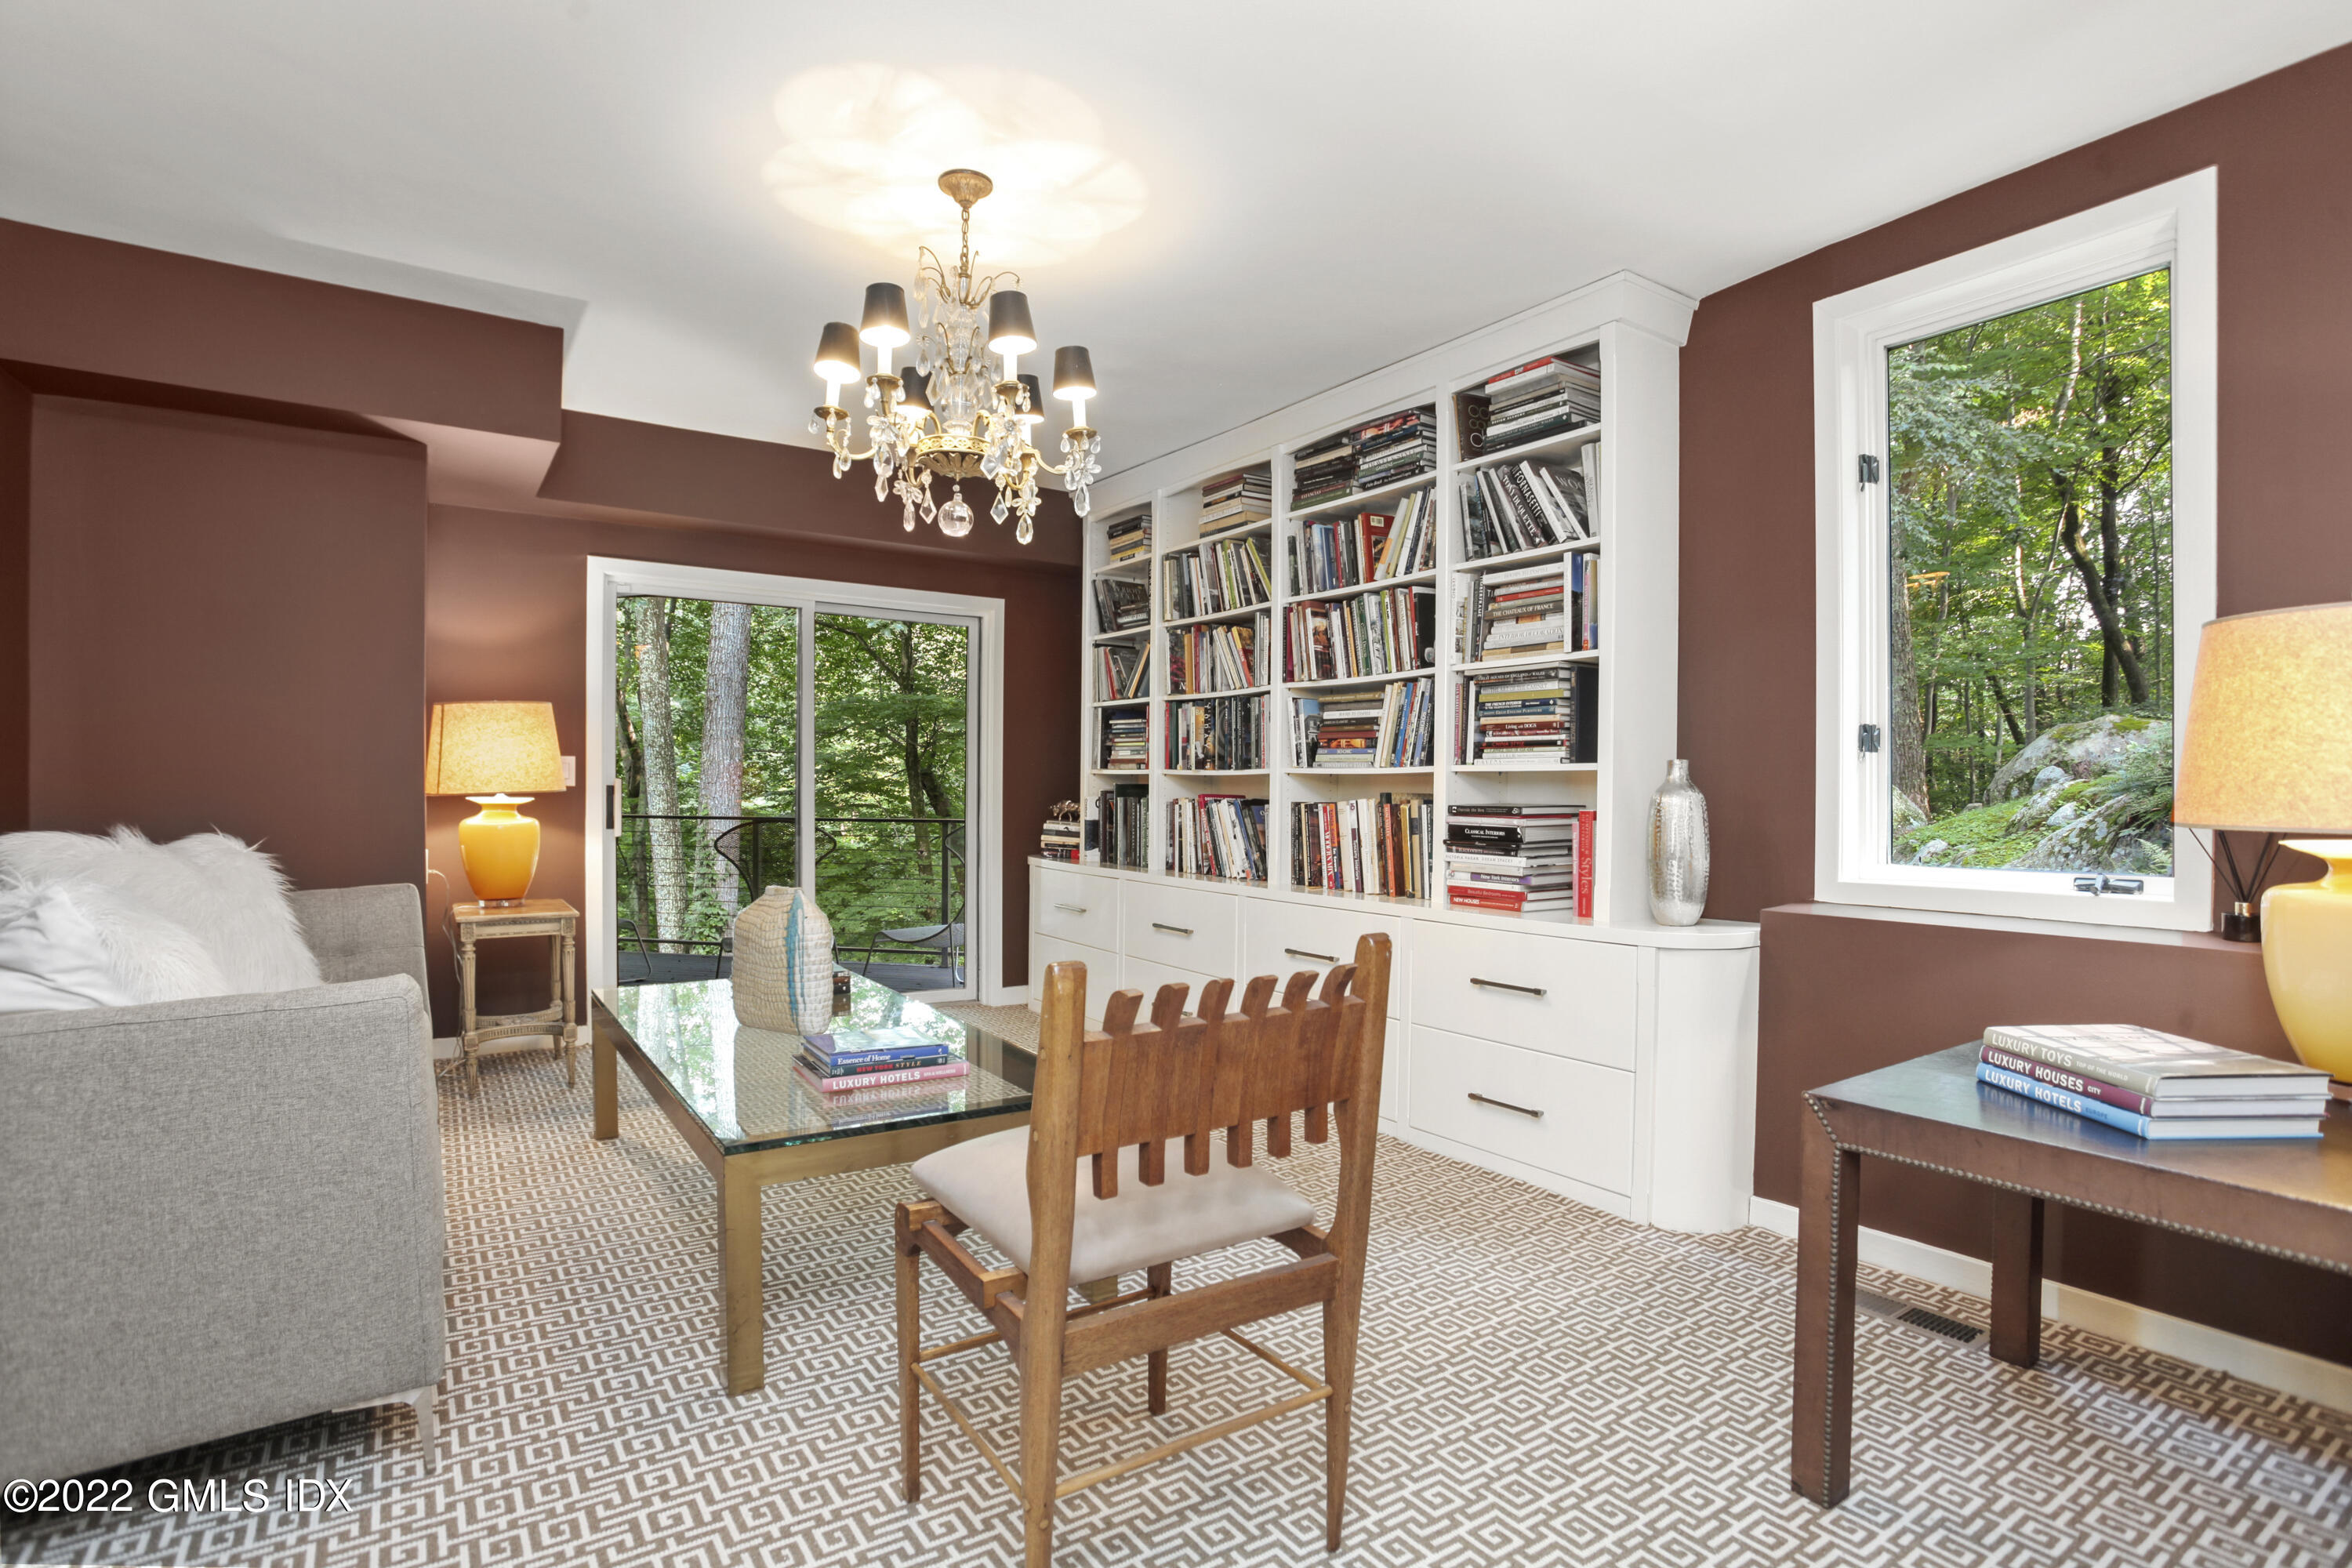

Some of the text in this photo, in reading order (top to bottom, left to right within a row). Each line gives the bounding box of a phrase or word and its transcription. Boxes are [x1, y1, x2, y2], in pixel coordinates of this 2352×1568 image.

[1514, 472, 1542, 517] FORNASETTI
[1579, 858, 1592, 894] Styles
[895, 1060, 922, 1069] STYLE
[1988, 1051, 2101, 1095] LUXURY HOUSES CITY
[1991, 1033, 2038, 1056] LUXURY
[2041, 1047, 2073, 1067] TOYS
[2096, 1067, 2107, 1076] THE
[2108, 1069, 2129, 1082] WORLD
[833, 1076, 877, 1090] LUXURY
[880, 1071, 920, 1084] HOTELS
[1985, 1069, 2107, 1120] LUXURY HOTELS EUROPE
